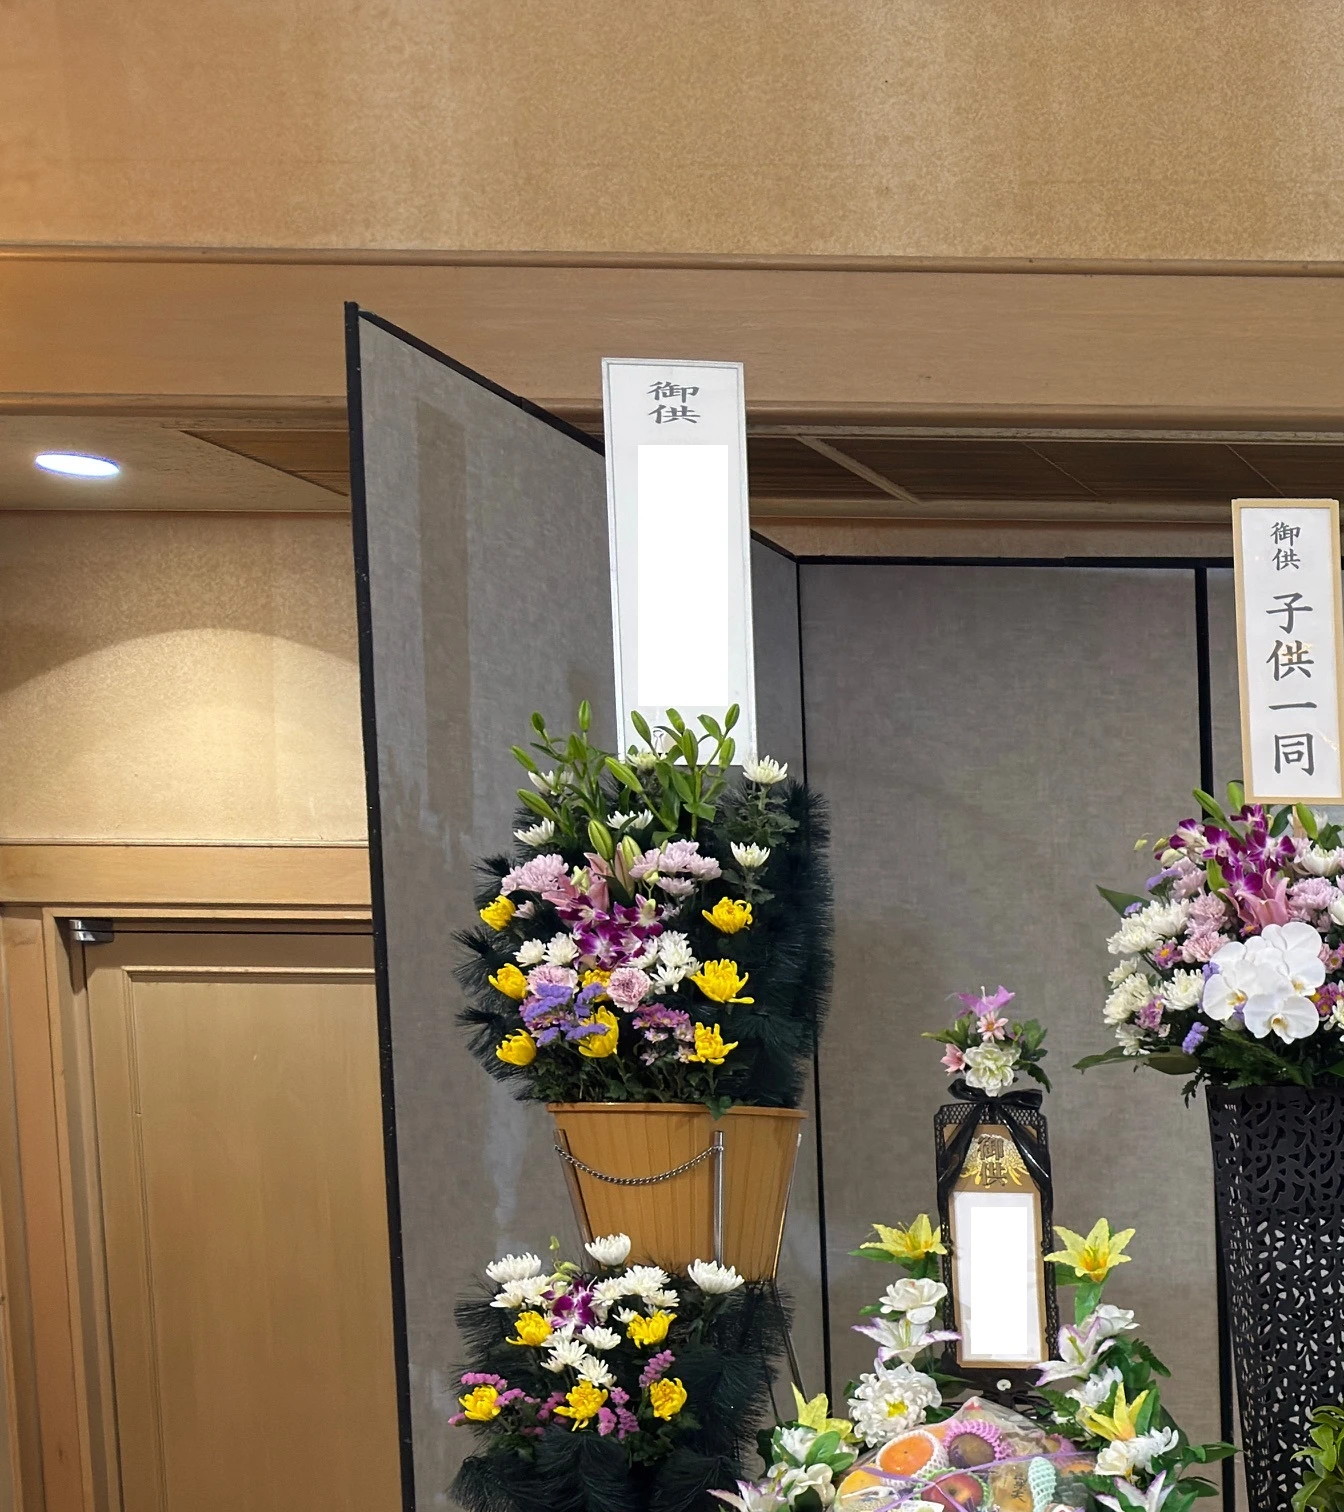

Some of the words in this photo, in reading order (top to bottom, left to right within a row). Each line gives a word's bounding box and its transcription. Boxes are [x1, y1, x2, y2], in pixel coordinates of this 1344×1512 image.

[646, 380, 701, 424] 御供
[1269, 521, 1301, 571] 御供
[1265, 592, 1318, 776] 子供一同
[977, 1136, 1007, 1187] 御供
